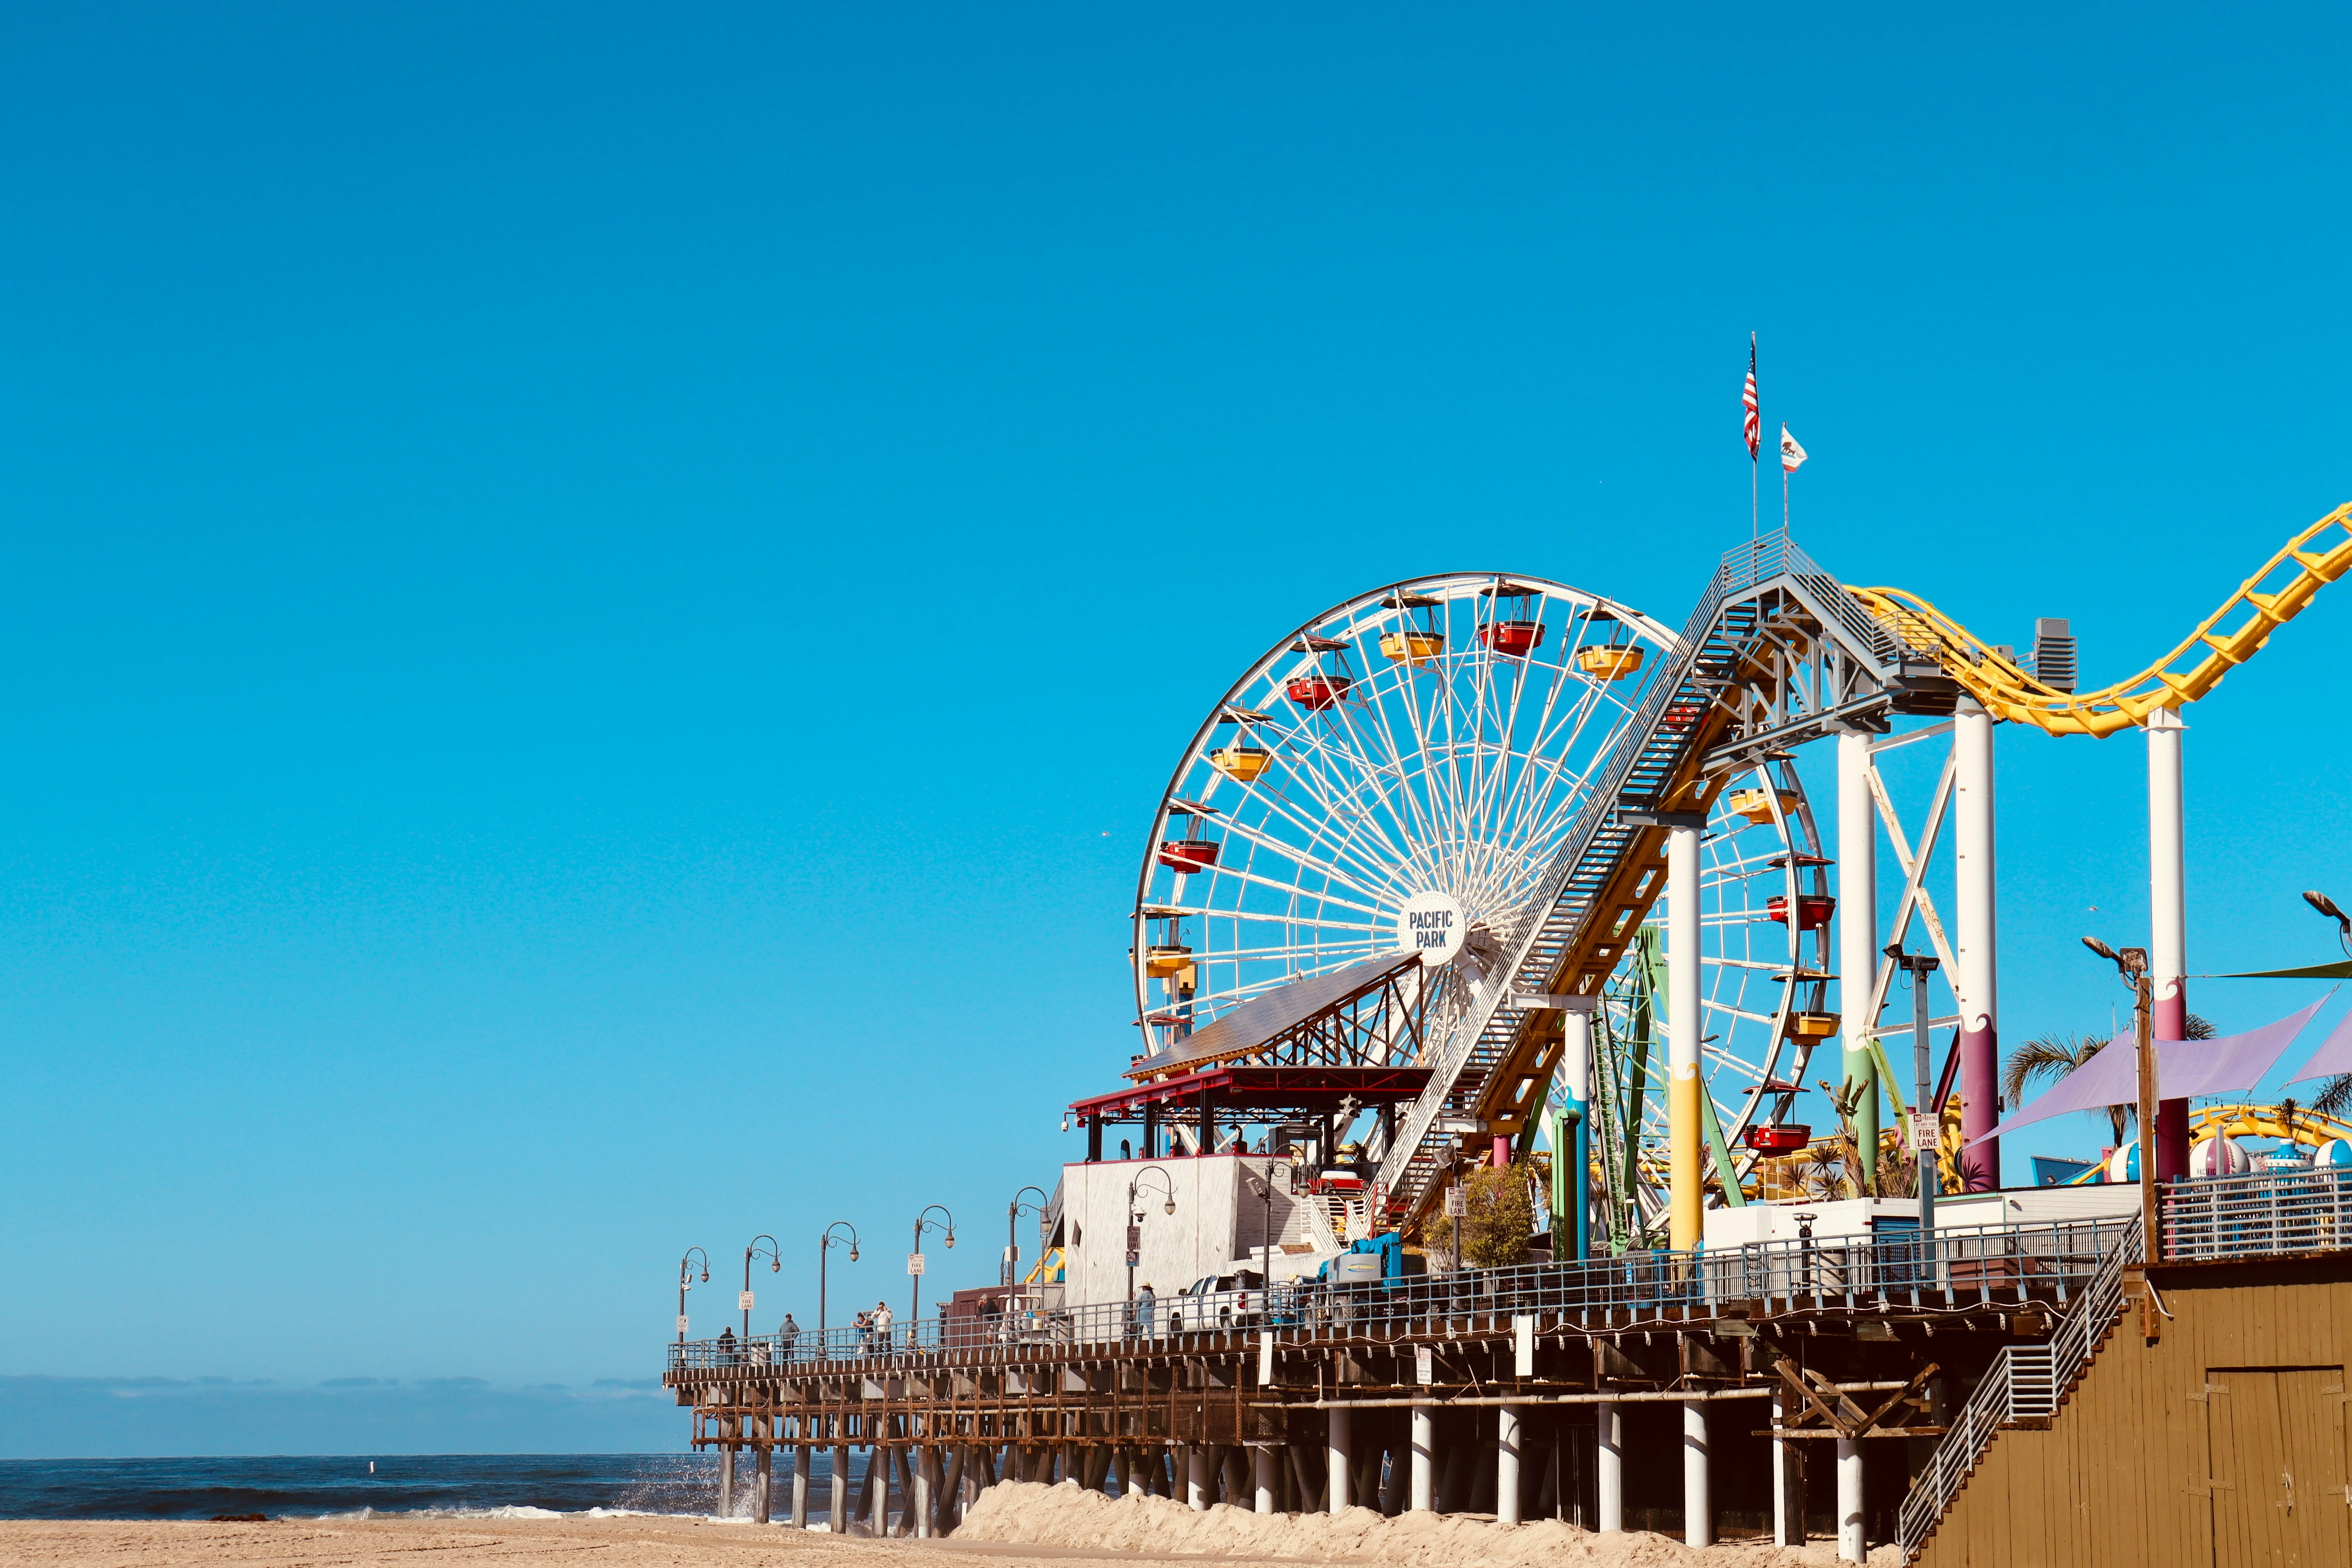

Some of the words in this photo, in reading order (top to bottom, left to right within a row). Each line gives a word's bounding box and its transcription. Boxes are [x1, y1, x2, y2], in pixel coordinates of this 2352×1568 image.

[1410, 910, 1453, 929] PACIFIC
[1416, 930, 1446, 948] PARK
[1918, 1129, 1935, 1138] FIRE
[1918, 1138, 1938, 1147] LANE
